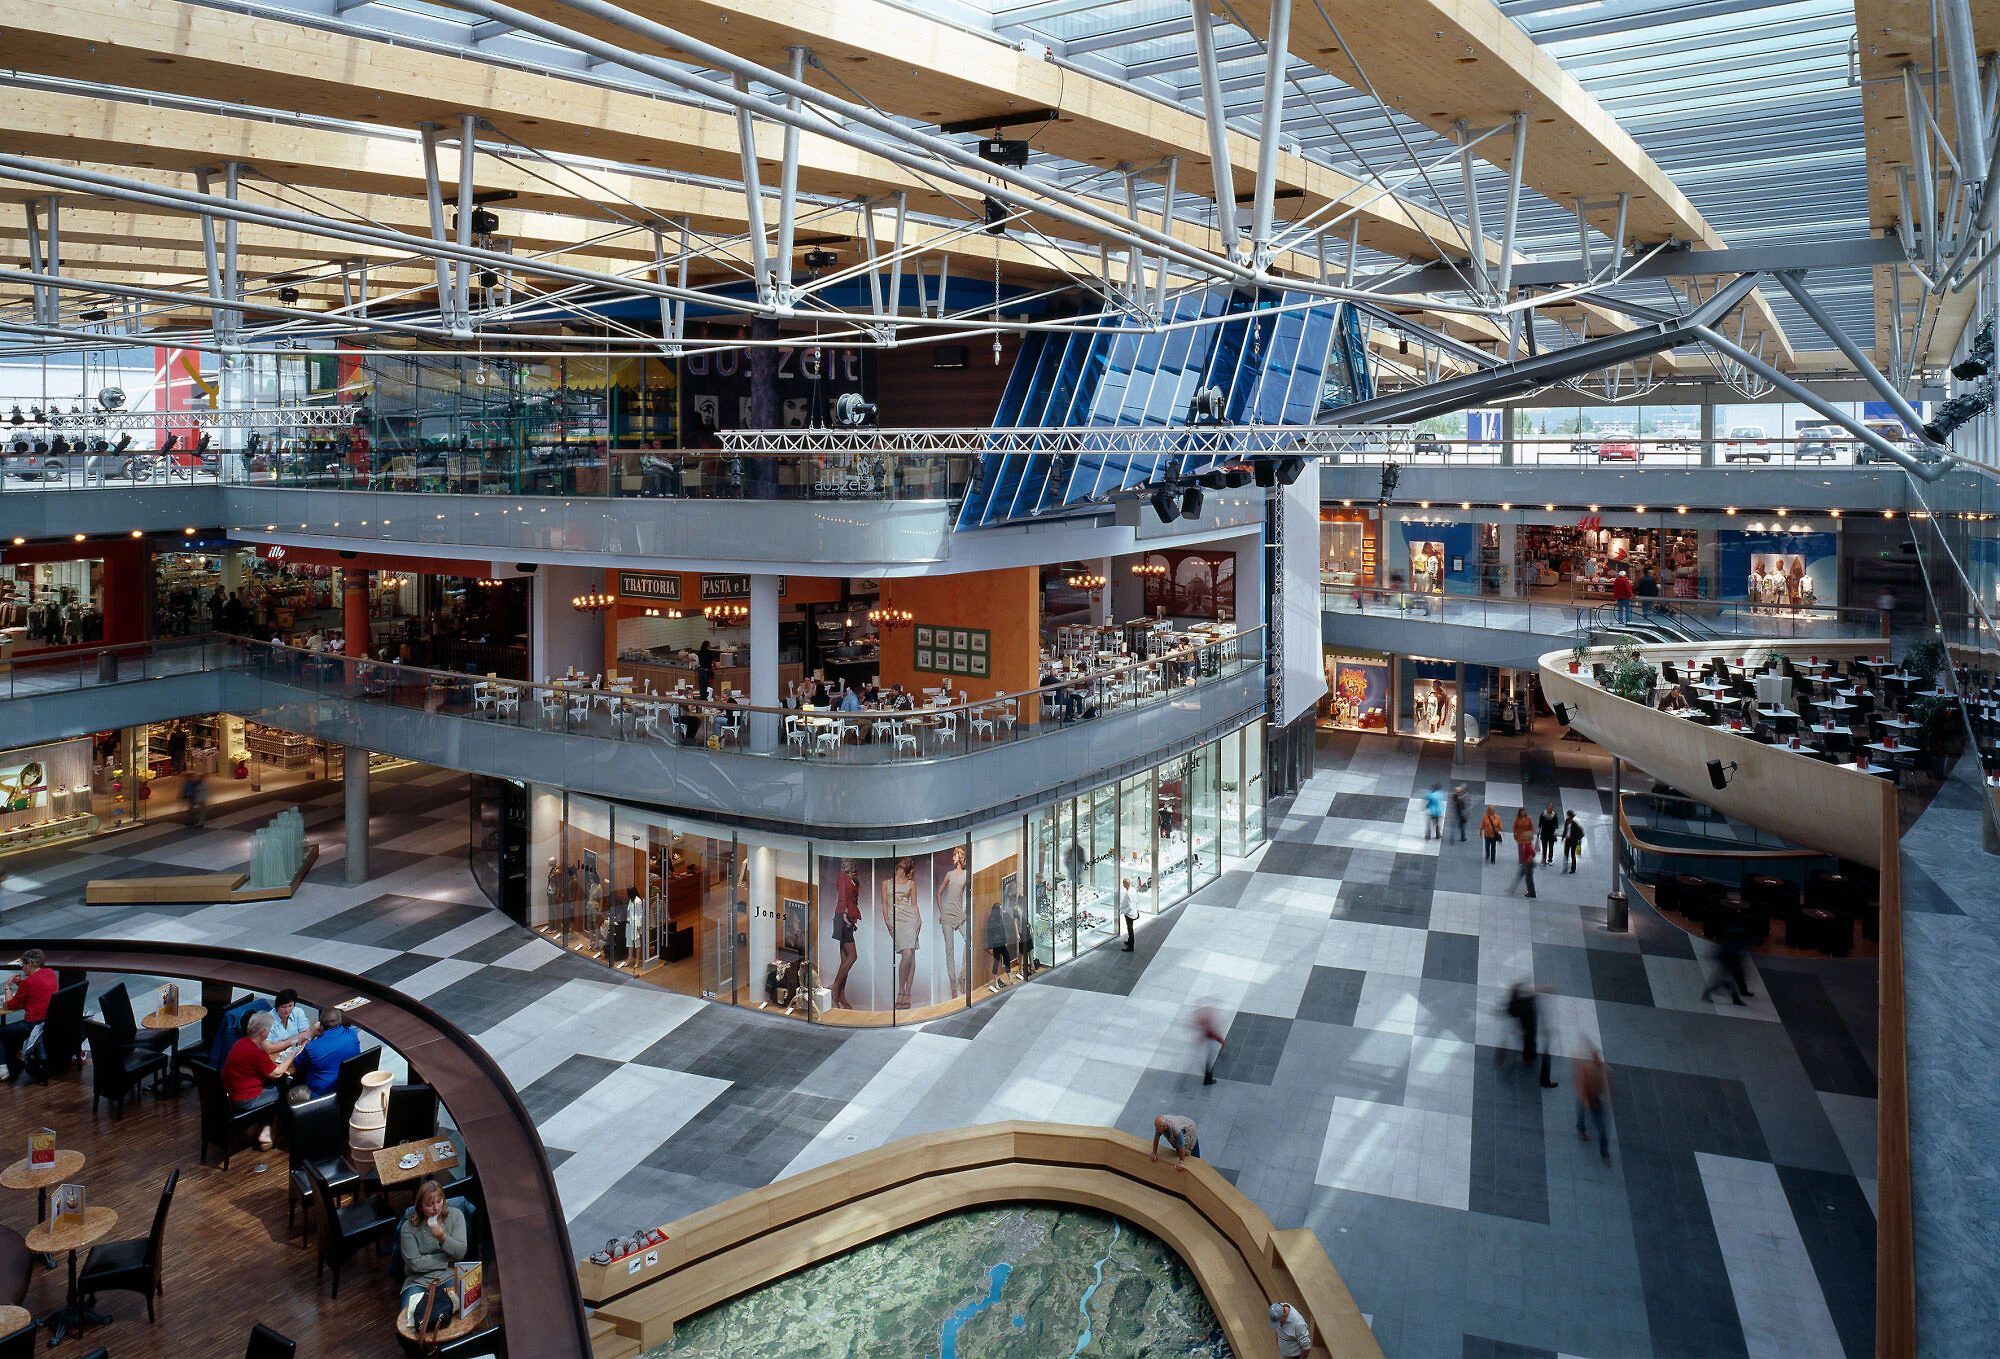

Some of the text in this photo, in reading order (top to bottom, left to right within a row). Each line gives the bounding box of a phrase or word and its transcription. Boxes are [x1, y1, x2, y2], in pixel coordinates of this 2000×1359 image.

[268, 545, 286, 560] illy
[624, 577, 676, 595] TRATTORIA
[703, 580, 731, 594] PASTA
[734, 583, 739, 593] e
[754, 905, 787, 921] Jones
